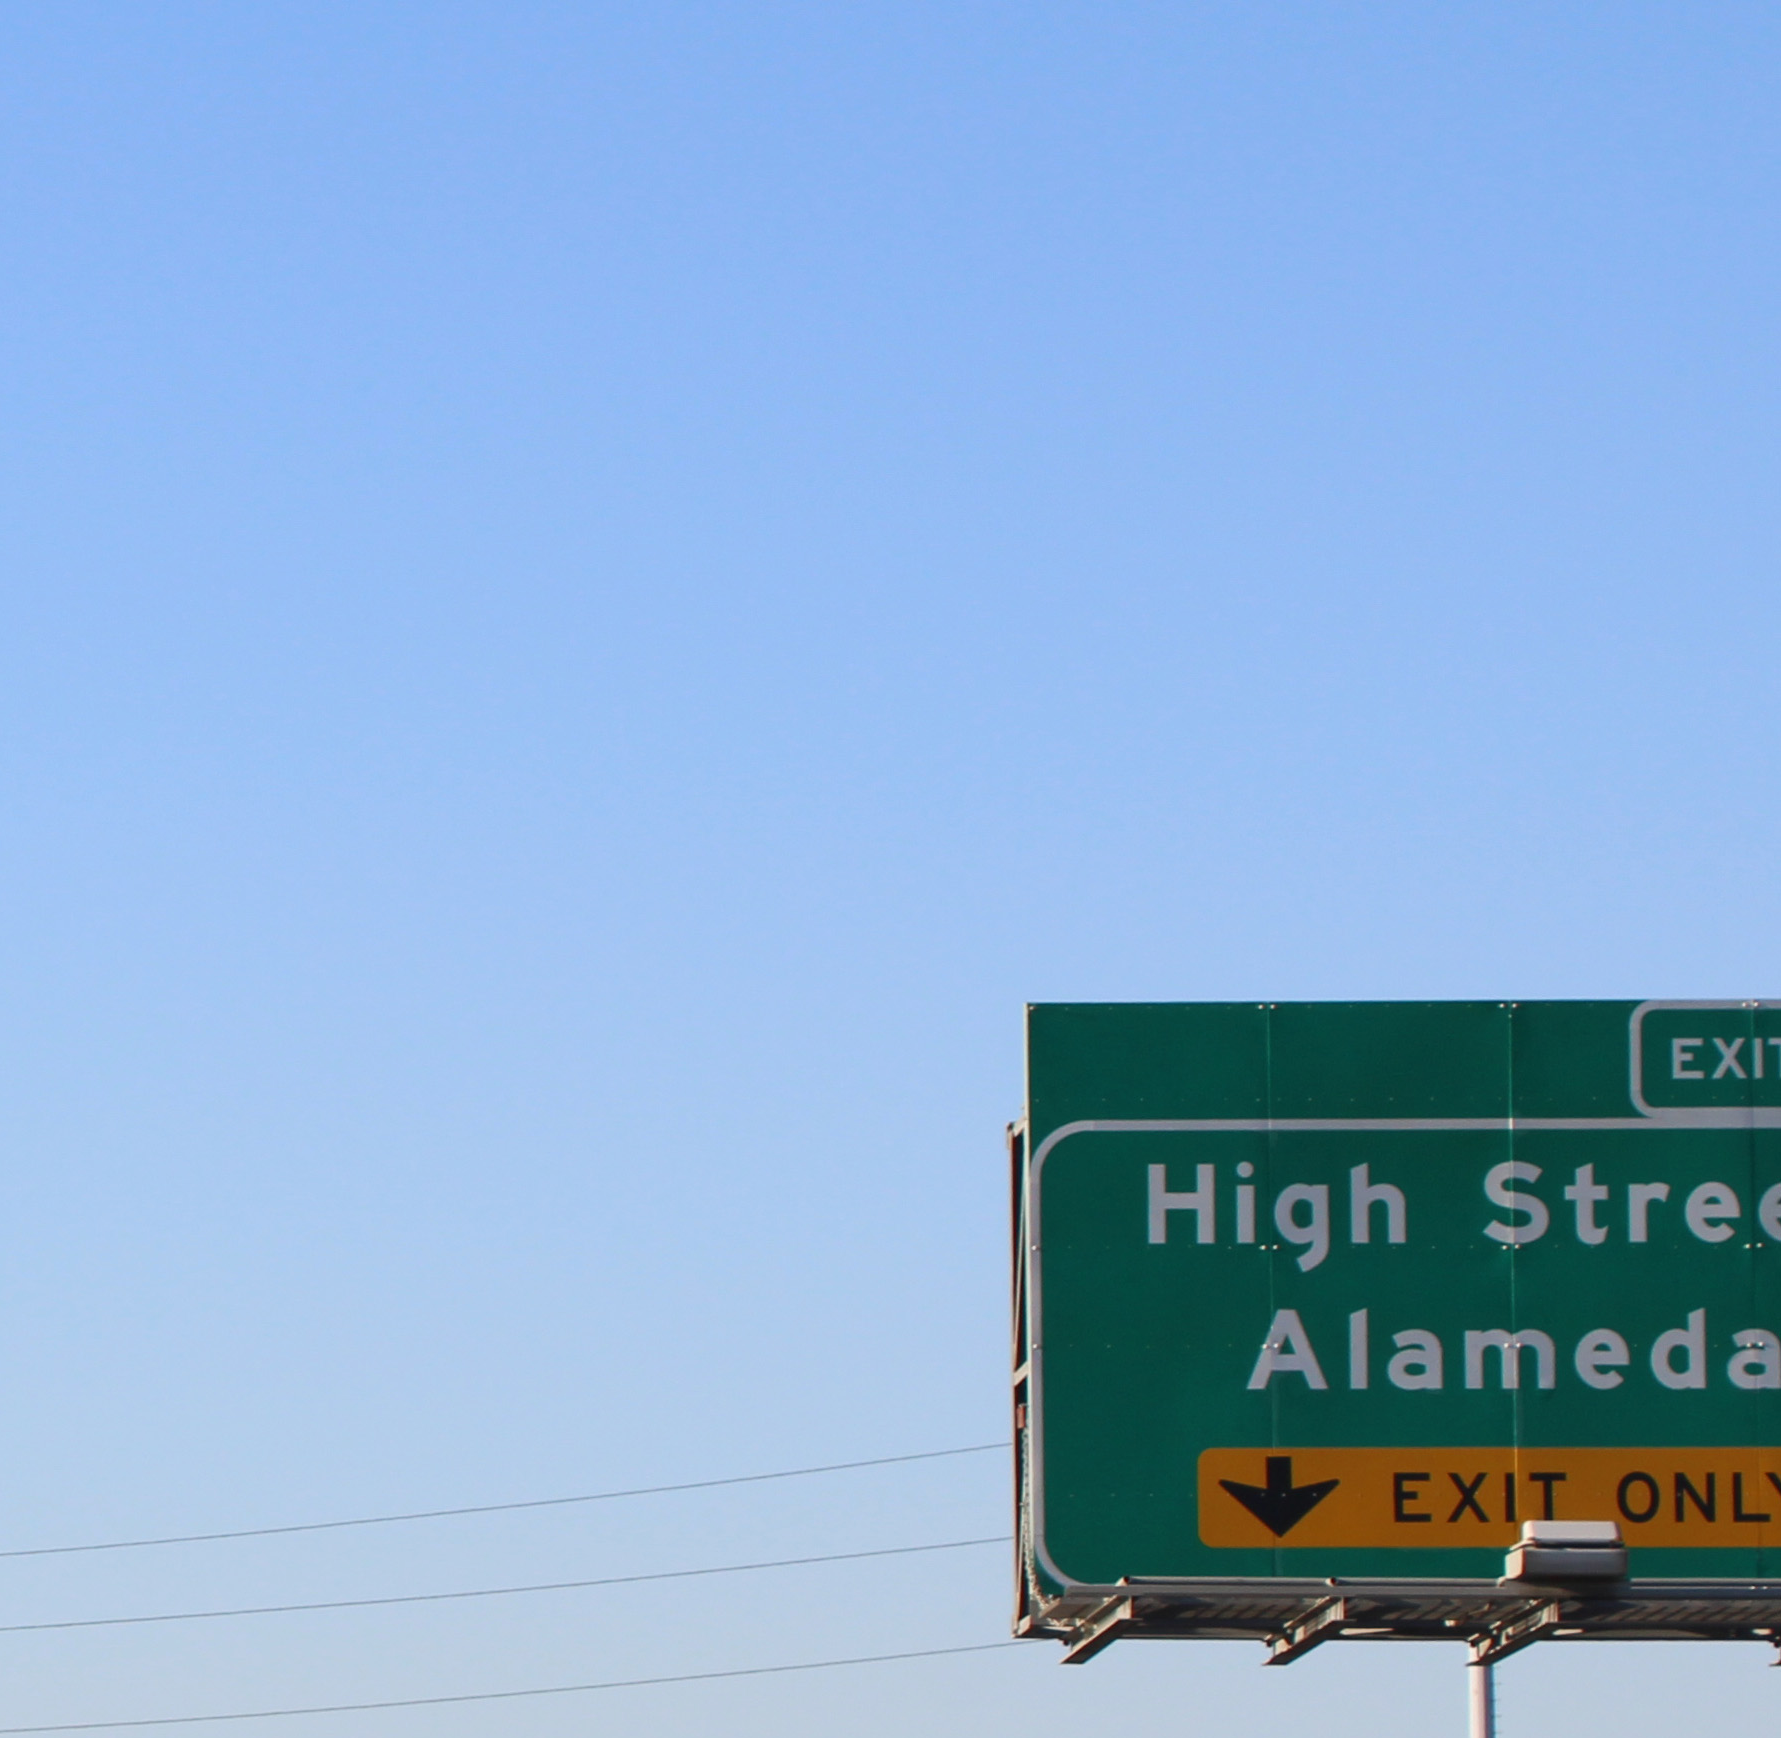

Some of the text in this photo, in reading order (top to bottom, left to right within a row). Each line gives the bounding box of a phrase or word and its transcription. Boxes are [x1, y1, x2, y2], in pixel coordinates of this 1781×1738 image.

[1147, 1161, 1406, 1272] High
[1247, 1308, 1781, 1392] Alameda
[1393, 1472, 1567, 1523] EXIT
